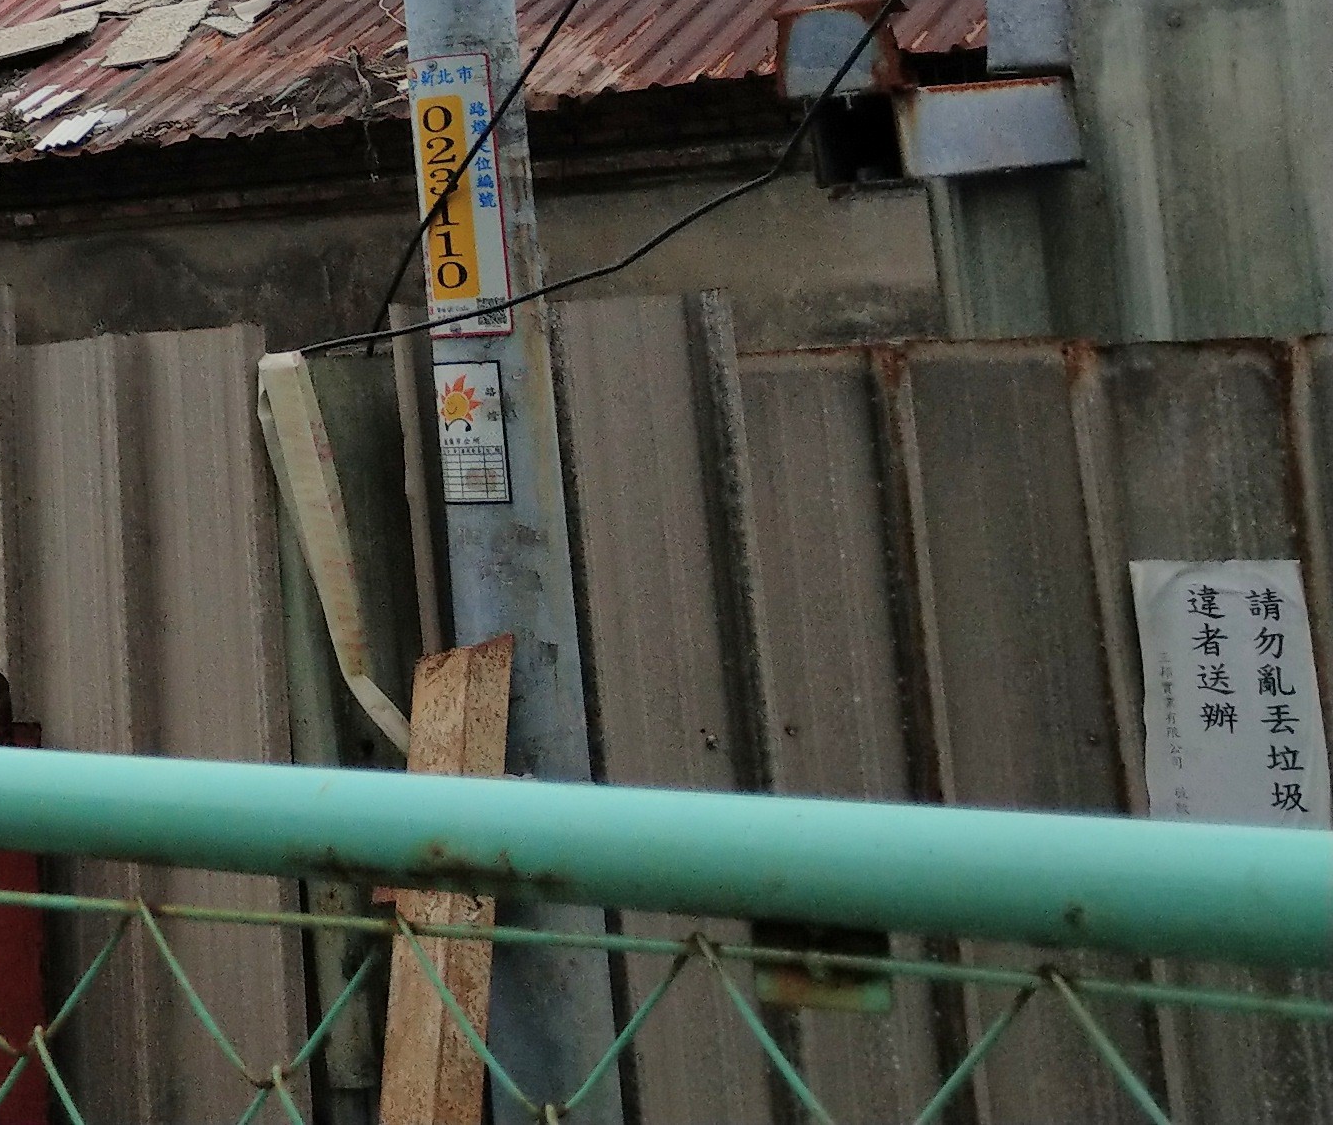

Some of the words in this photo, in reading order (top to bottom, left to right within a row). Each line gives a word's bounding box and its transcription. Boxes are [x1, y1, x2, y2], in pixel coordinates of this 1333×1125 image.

[420, 65, 474, 87] 新北市
[422, 105, 469, 290] 023110
[1186, 584, 1239, 735] 違者送辦
[1245, 587, 1309, 813] 請勿亂丟垃圾
